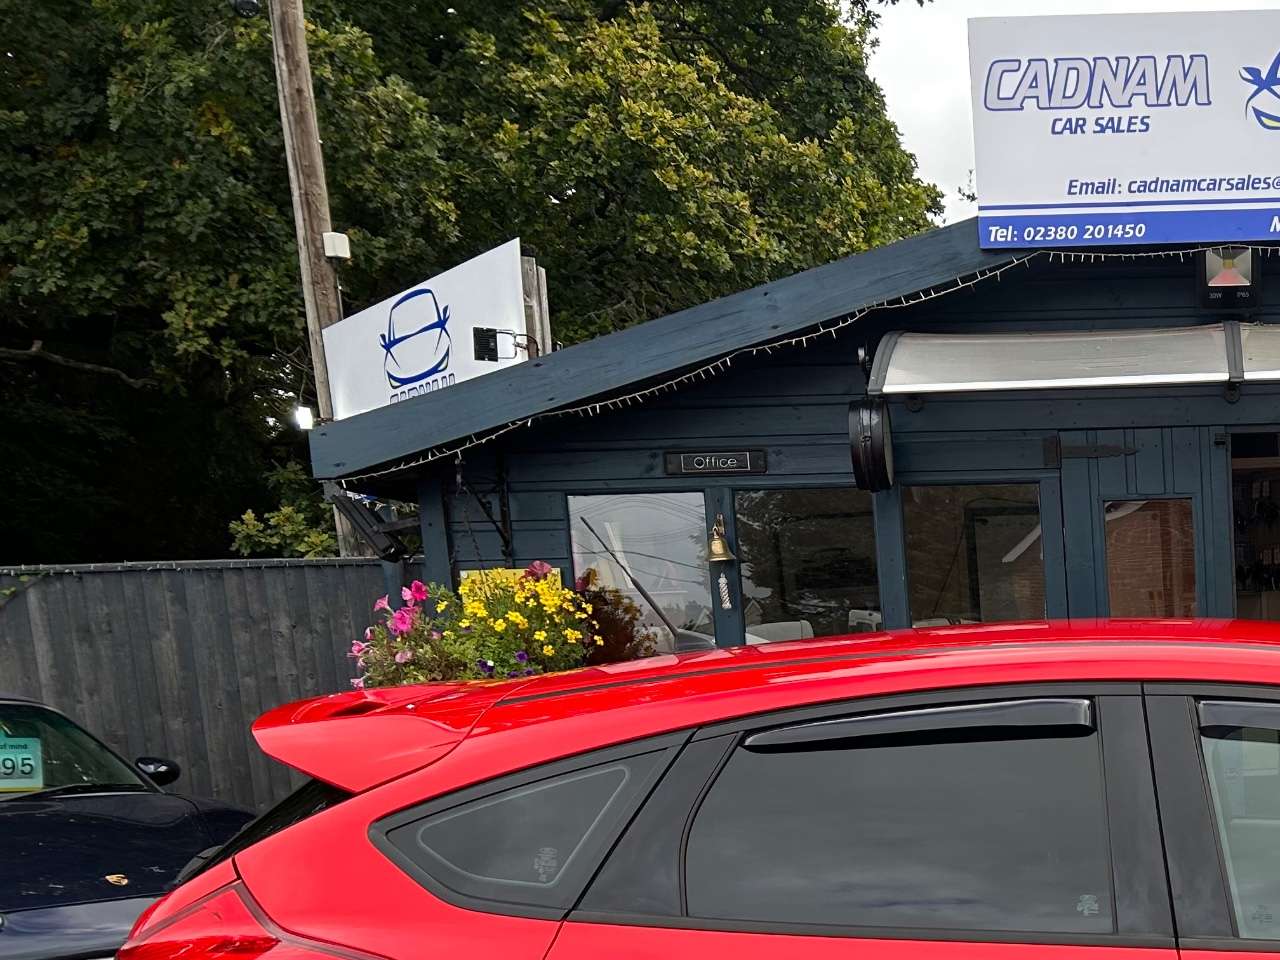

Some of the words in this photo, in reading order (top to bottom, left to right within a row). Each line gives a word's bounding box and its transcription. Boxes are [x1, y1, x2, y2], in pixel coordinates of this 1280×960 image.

[984, 54, 1212, 111] CADNAM
[1051, 117, 1087, 135] CAR
[1092, 115, 1150, 134] SALES
[1067, 177, 1122, 196] Email:
[988, 225, 1018, 242] Tel:
[1023, 225, 1078, 241] 02380
[1082, 223, 1146, 240] 201450
[693, 456, 737, 469] Office
